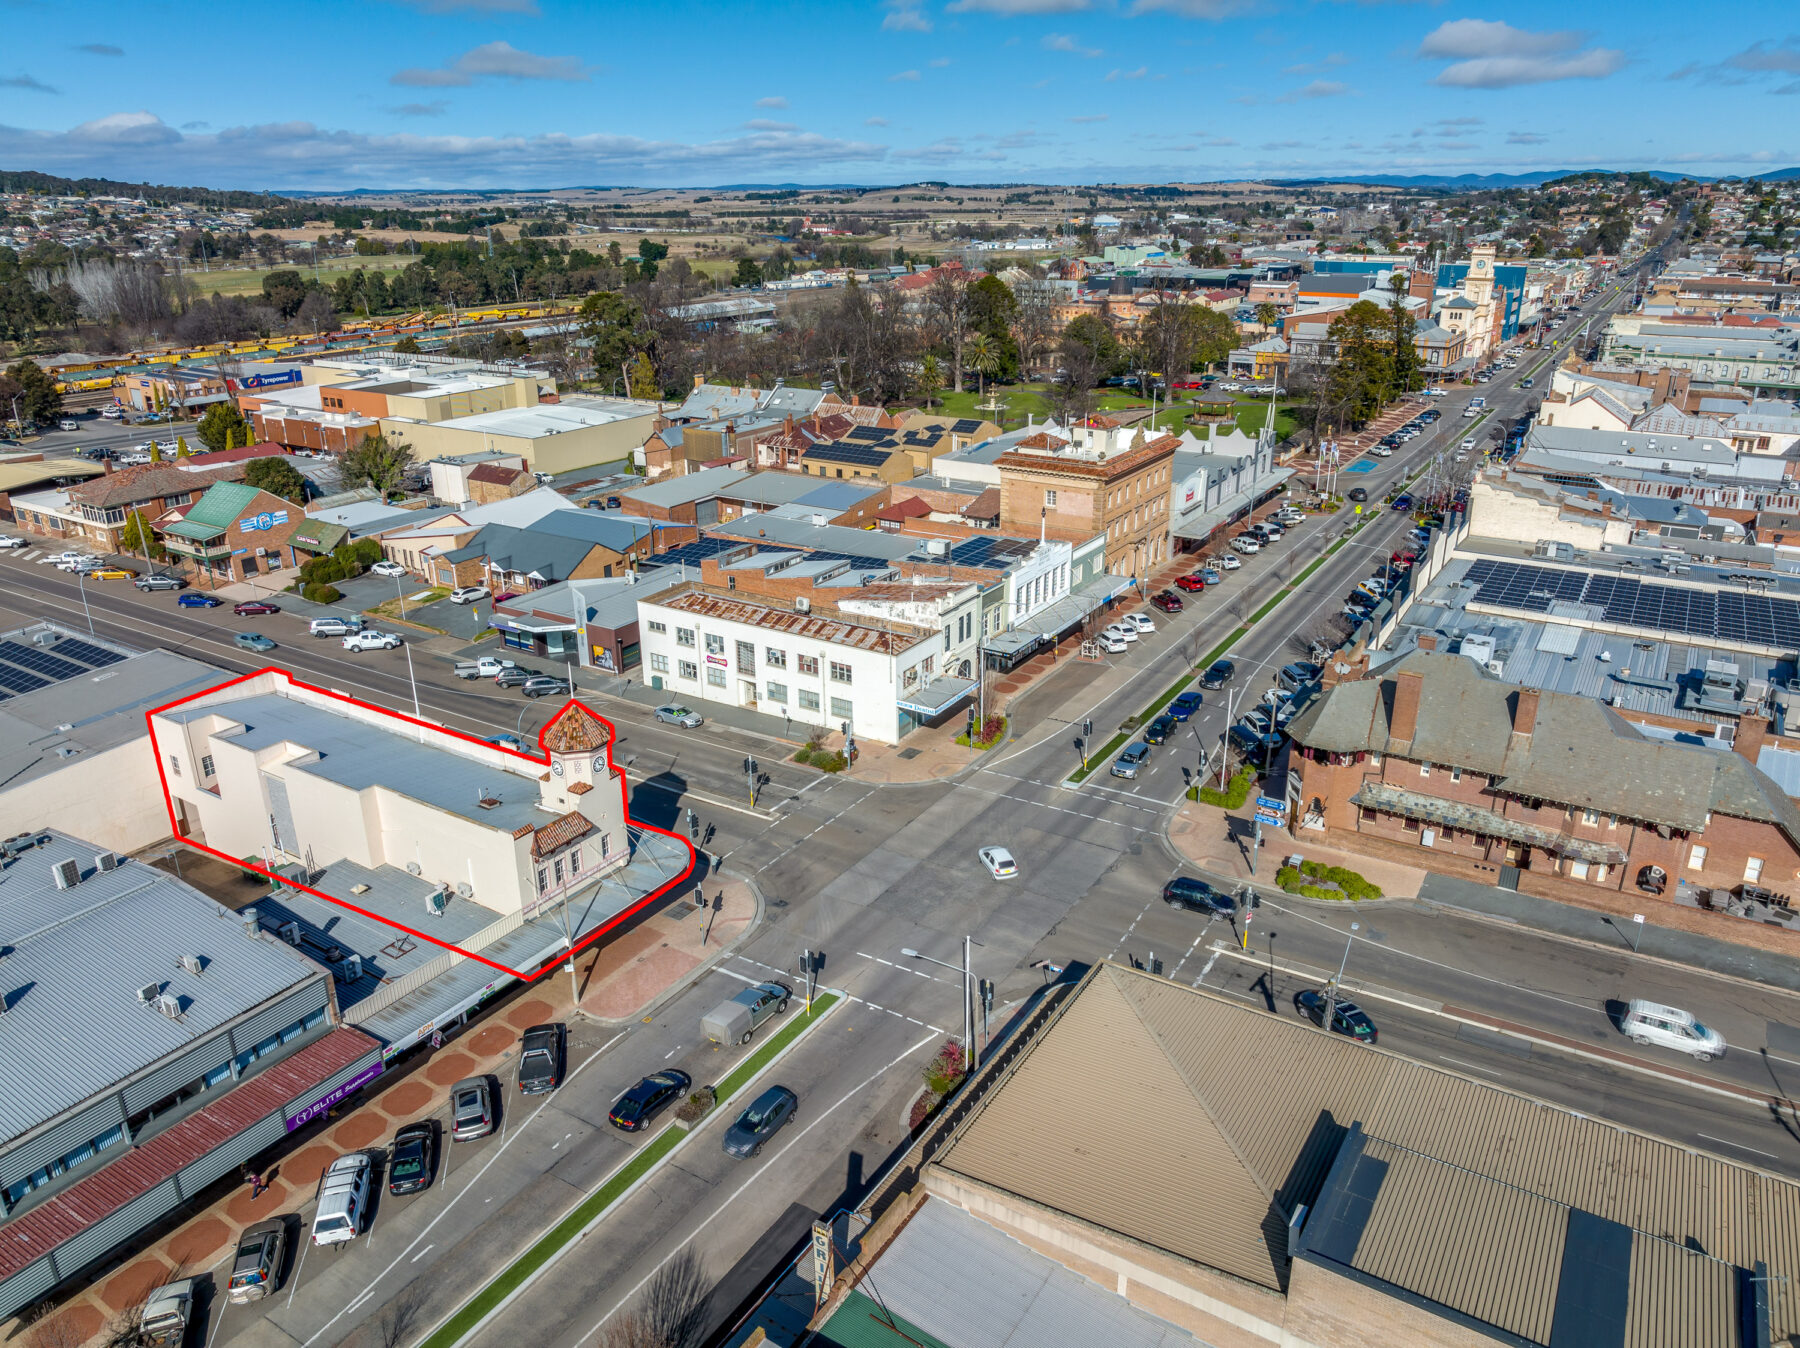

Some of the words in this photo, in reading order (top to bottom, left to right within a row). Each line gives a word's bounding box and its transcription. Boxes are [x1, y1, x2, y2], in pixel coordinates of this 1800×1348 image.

[262, 376, 289, 385] Tyrepower
[914, 704, 936, 715] Dentist
[417, 1021, 435, 1038] APM
[313, 1089, 343, 1113] ELITE
